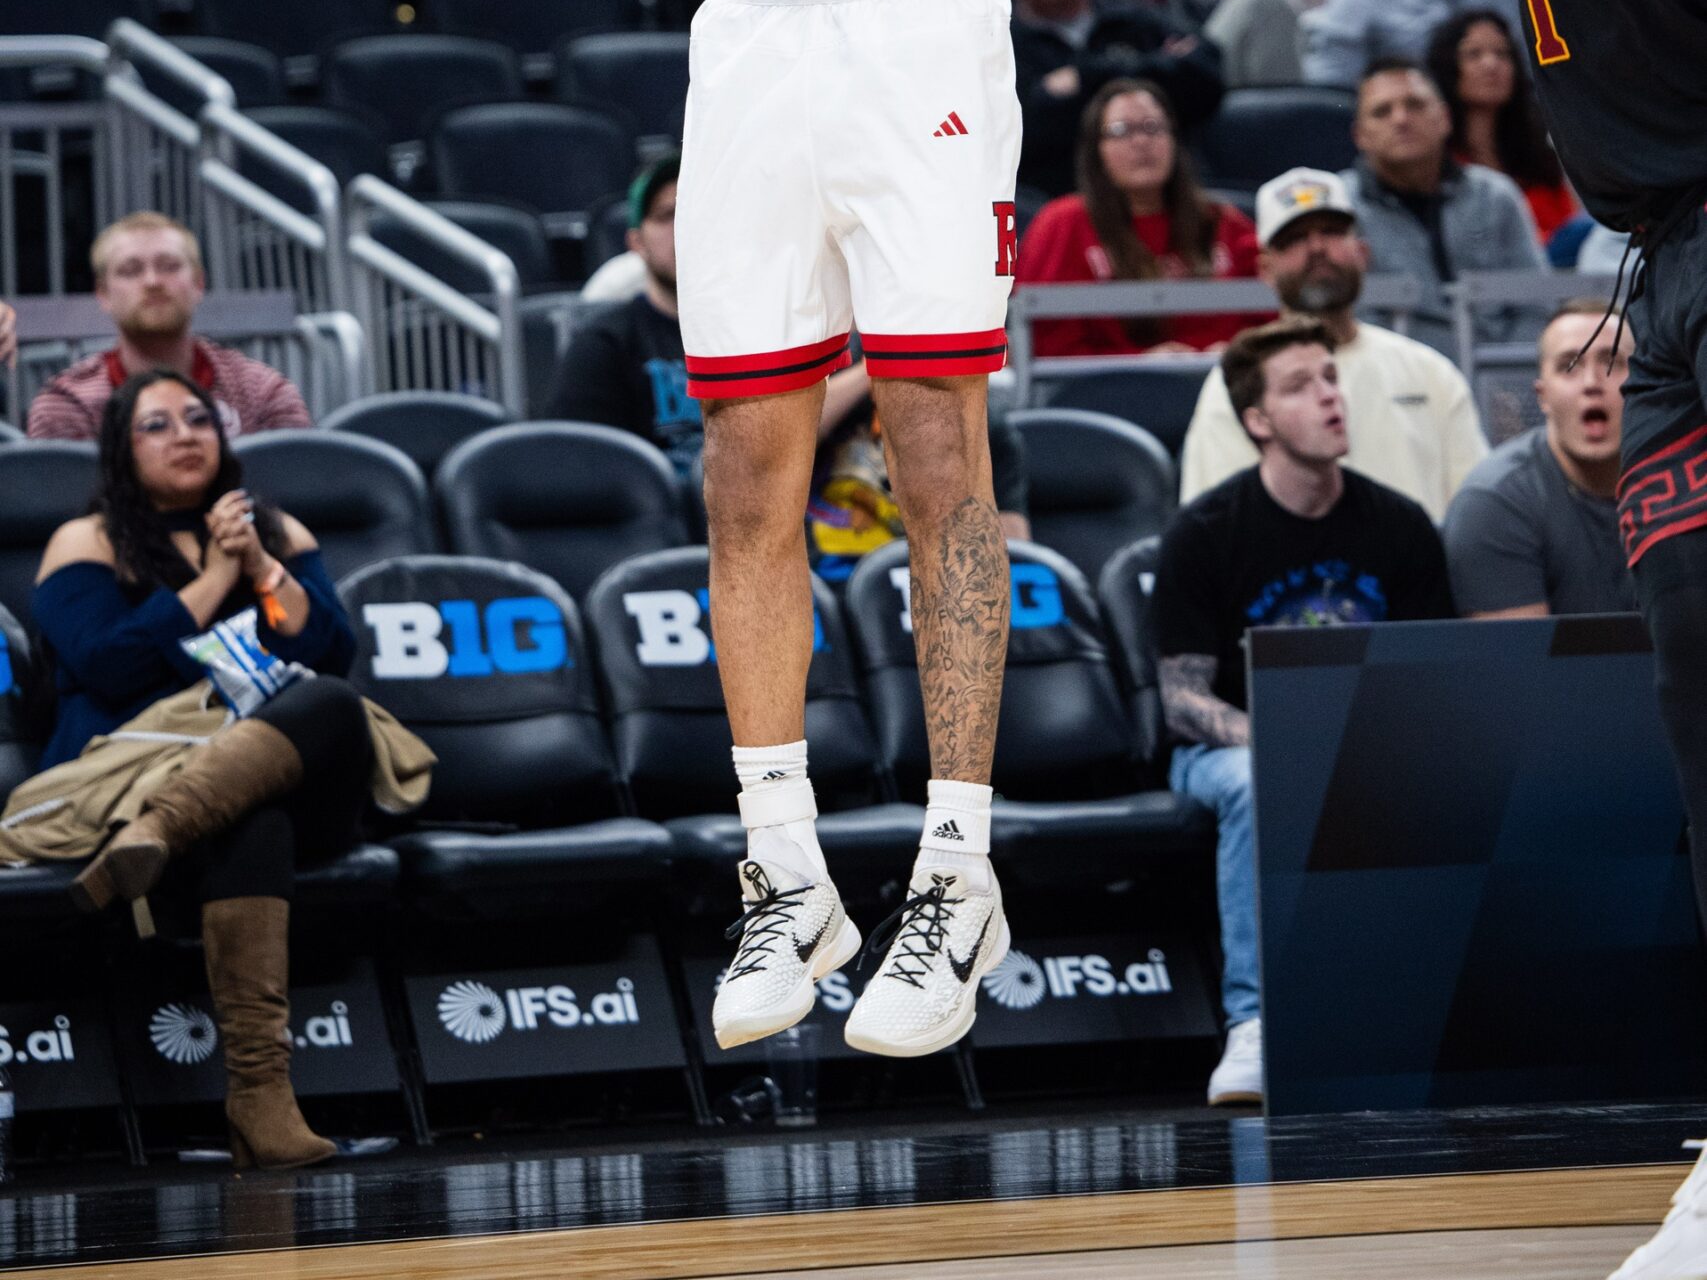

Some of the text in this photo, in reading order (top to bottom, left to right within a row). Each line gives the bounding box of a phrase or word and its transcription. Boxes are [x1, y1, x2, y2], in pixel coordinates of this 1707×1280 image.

[992, 201, 1017, 277] R
[932, 830, 965, 841] adidas
[1044, 948, 1173, 998] IFS.ai
[283, 1000, 353, 1048] .ai
[505, 977, 640, 1030] IFS.ai
[0, 1014, 75, 1066] .ai
